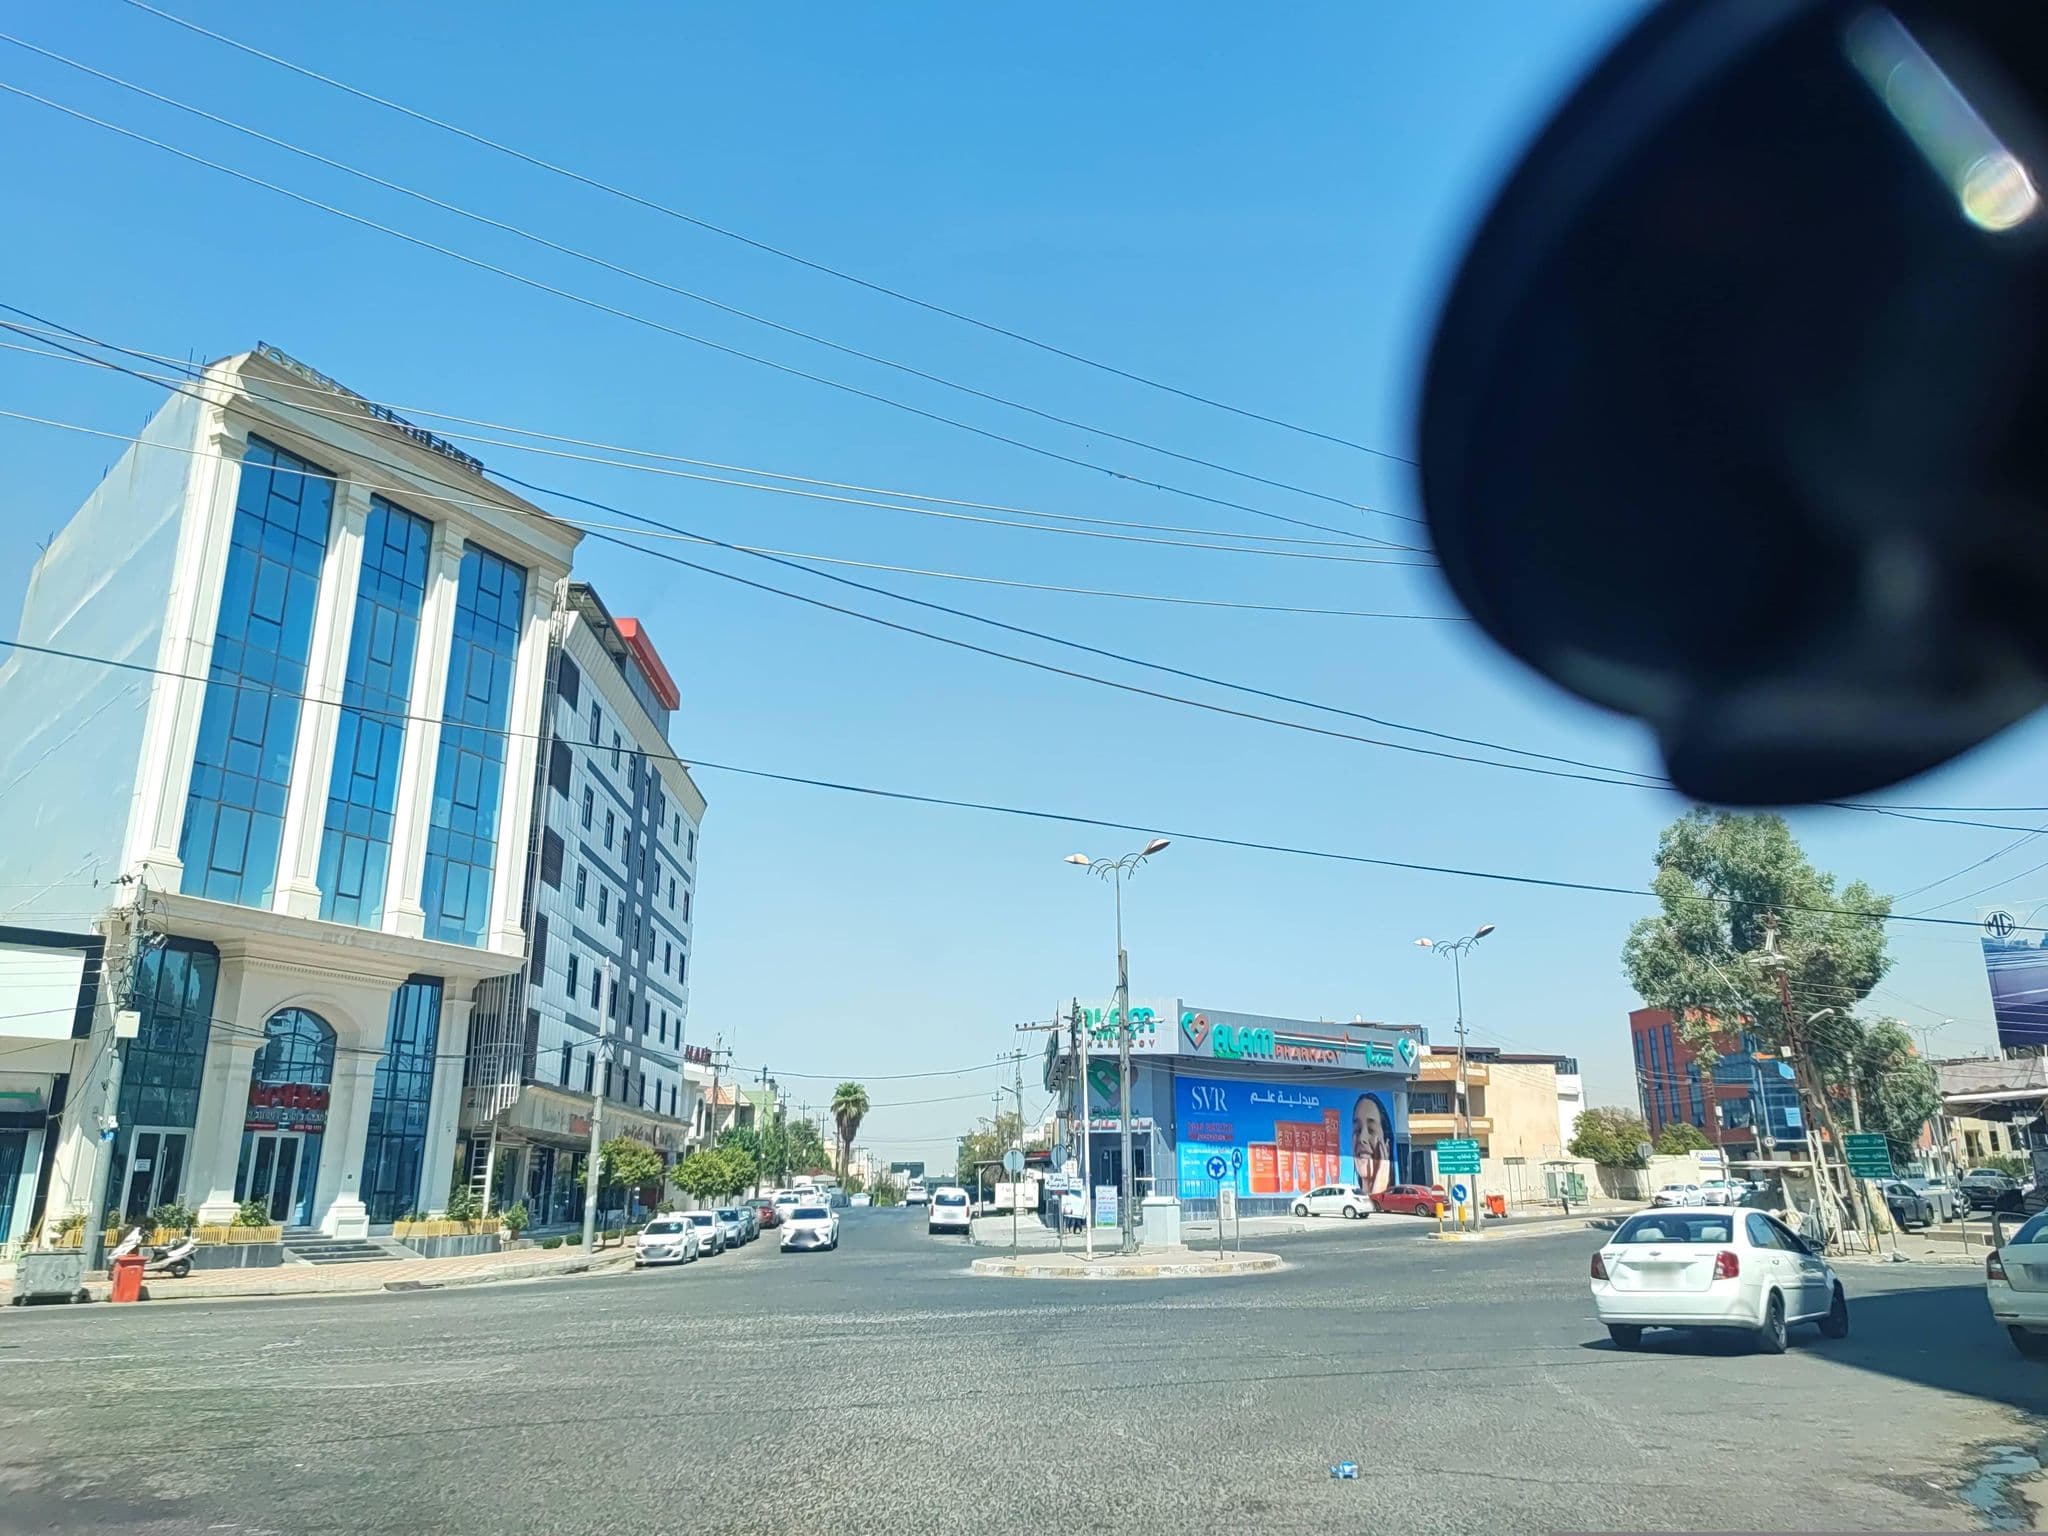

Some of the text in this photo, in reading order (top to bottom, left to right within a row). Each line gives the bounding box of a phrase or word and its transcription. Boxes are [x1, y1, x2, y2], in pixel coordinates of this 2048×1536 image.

[1987, 913, 2013, 937] MG
[1212, 1023, 1275, 1059] ALAM
[1274, 1044, 1341, 1065] PHARMACY
[1191, 1085, 1228, 1112] SVR
[1250, 1089, 1320, 1109] صيدلية علم
